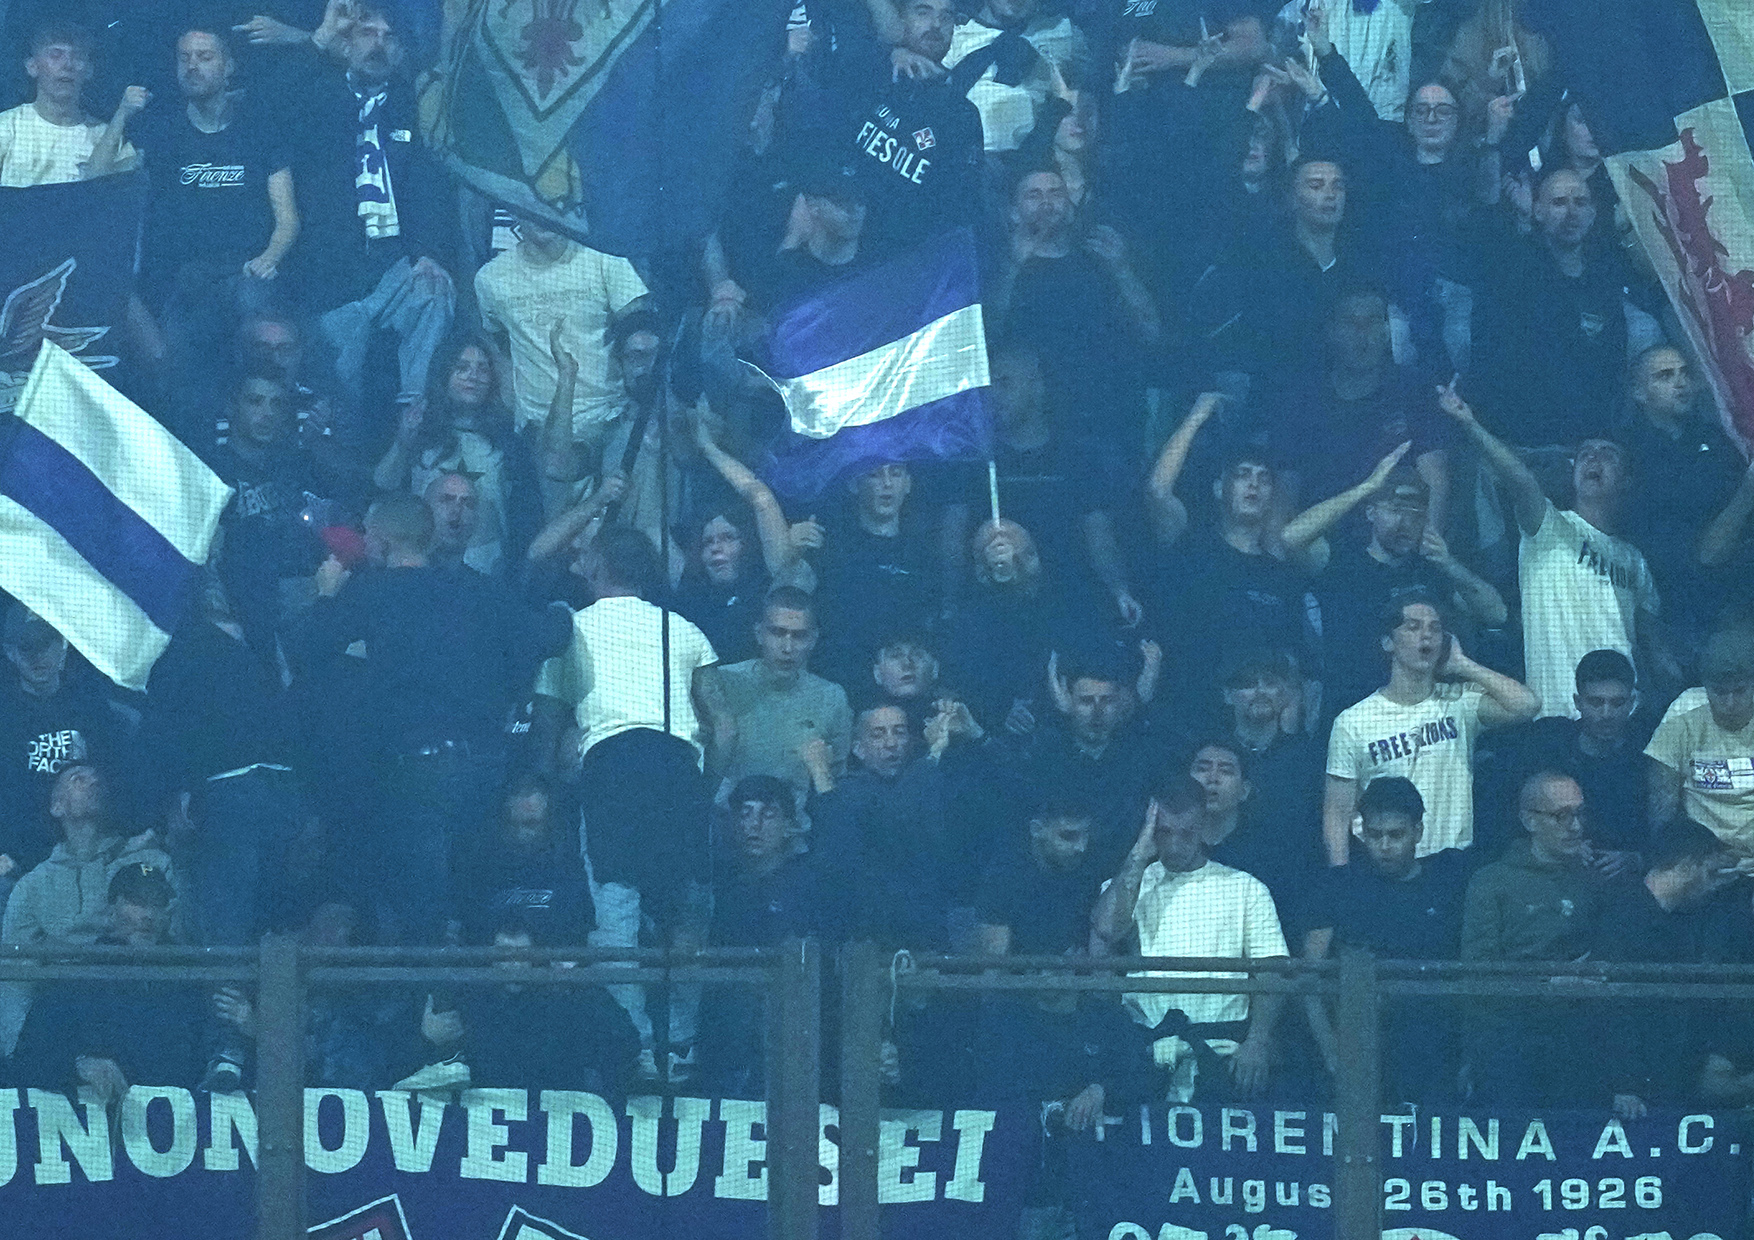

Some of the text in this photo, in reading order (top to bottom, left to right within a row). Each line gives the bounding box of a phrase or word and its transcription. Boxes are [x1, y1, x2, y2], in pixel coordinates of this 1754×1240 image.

[855, 121, 931, 185] FIESOLE
[180, 162, 245, 185] Firenze
[39, 729, 72, 748] THE
[1419, 716, 1458, 748] LIONS
[28, 755, 63, 774] FAC
[1368, 732, 1412, 767] FREE
[1592, 1113, 1741, 1162] A.C.
[1168, 1167, 1664, 1214] Augus 26th 1926
